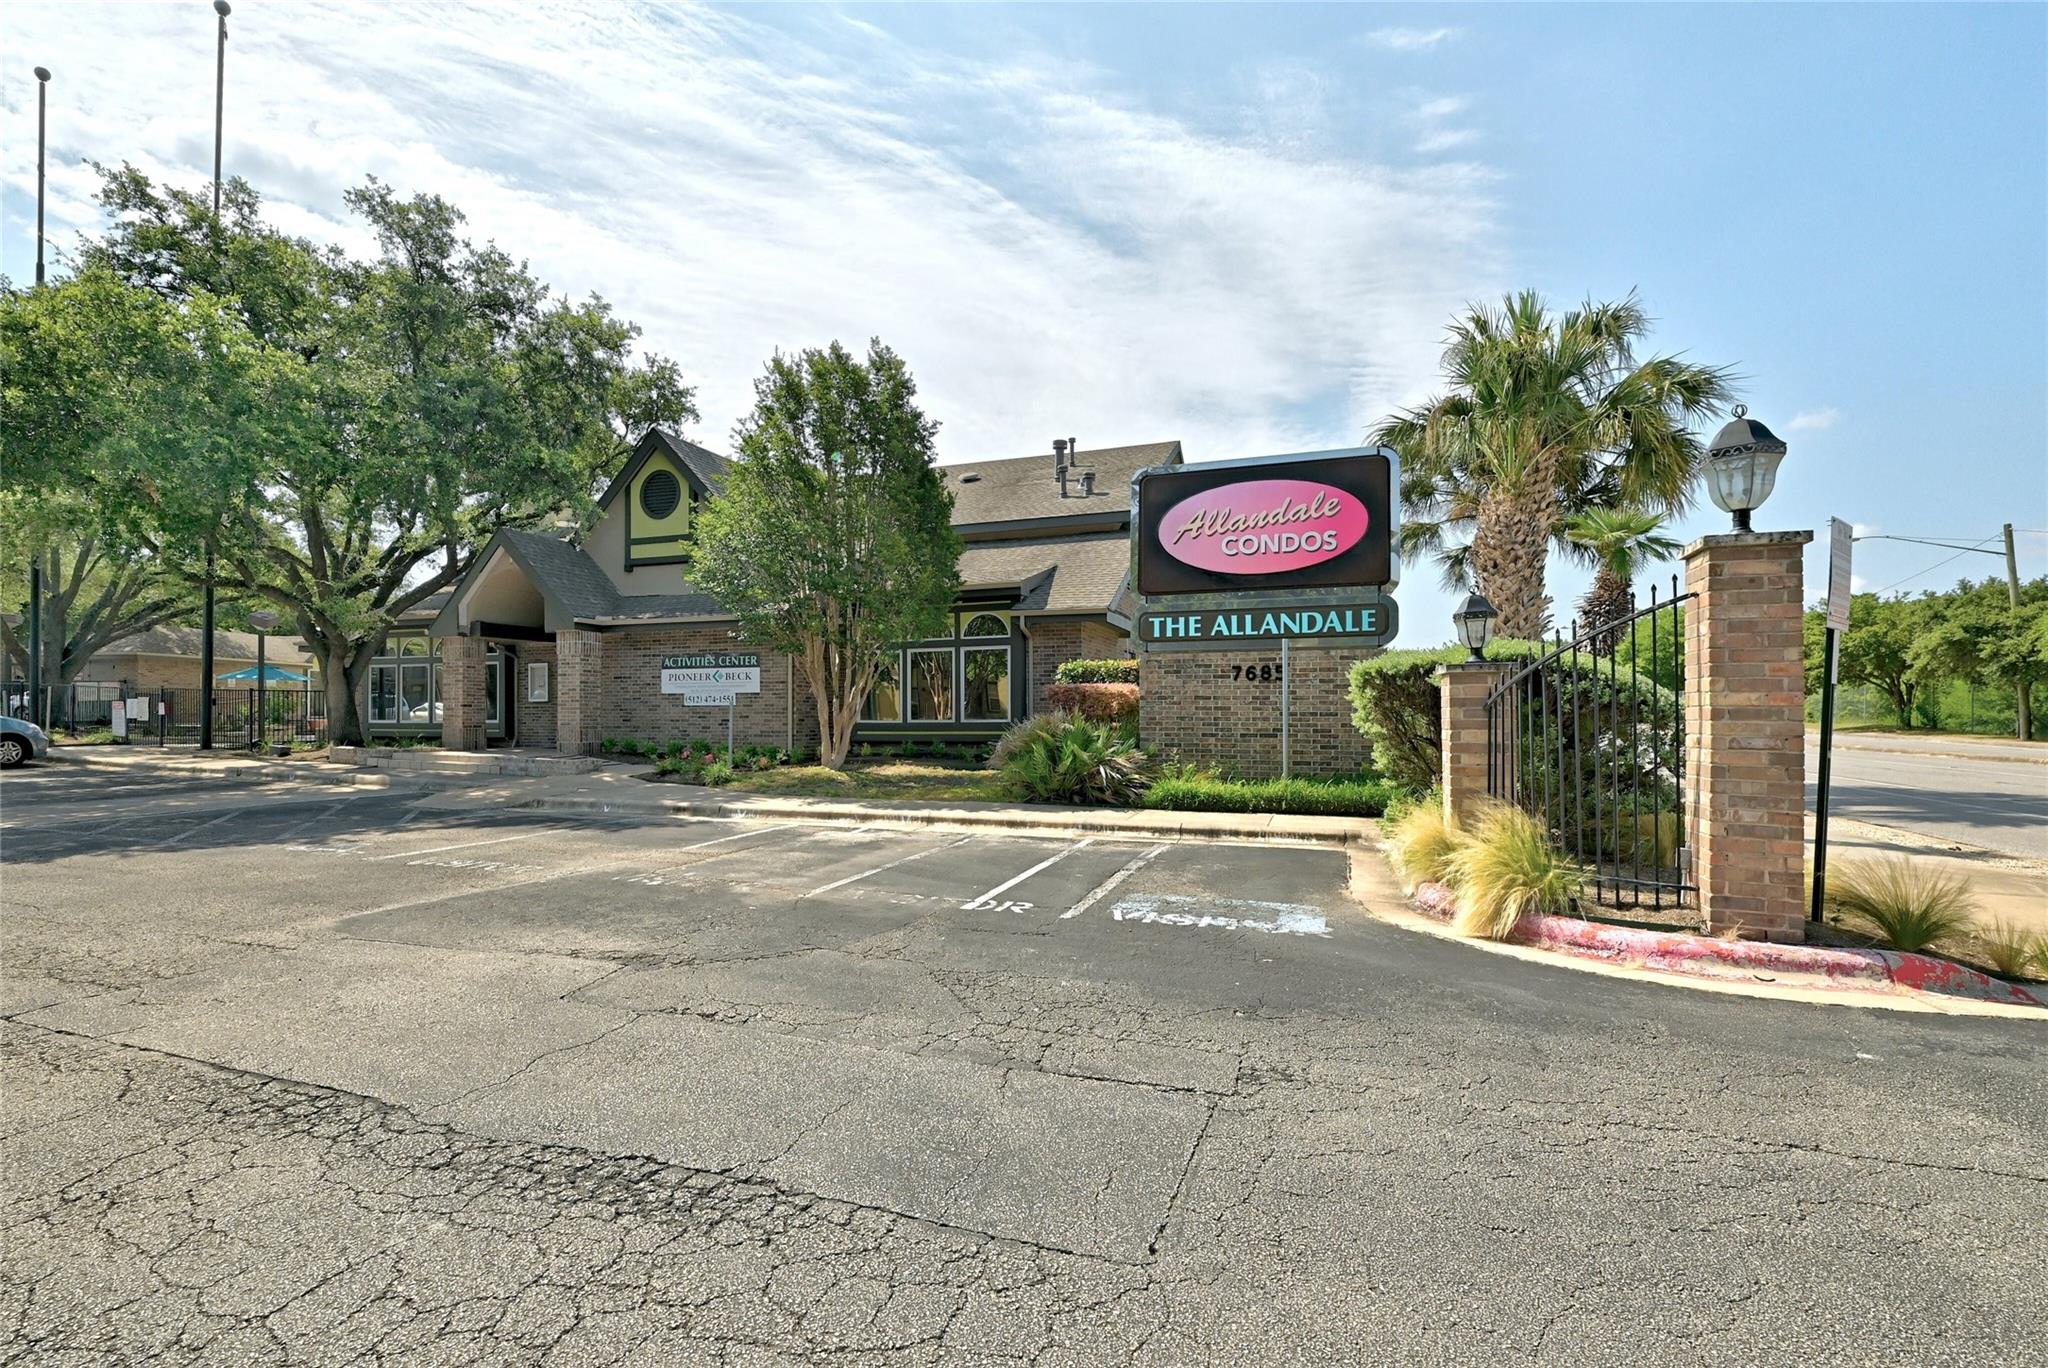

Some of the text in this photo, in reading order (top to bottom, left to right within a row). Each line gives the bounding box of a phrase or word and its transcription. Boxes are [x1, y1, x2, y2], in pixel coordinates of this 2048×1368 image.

[1173, 490, 1342, 544] Allandale
[1221, 530, 1338, 557] CONDOS
[1149, 609, 1376, 638] THE ALLANDALE
[664, 656, 758, 667] ACTIVITIES CENTER
[668, 672, 752, 682] PIONEER BECK
[685, 695, 703, 705] (512)
